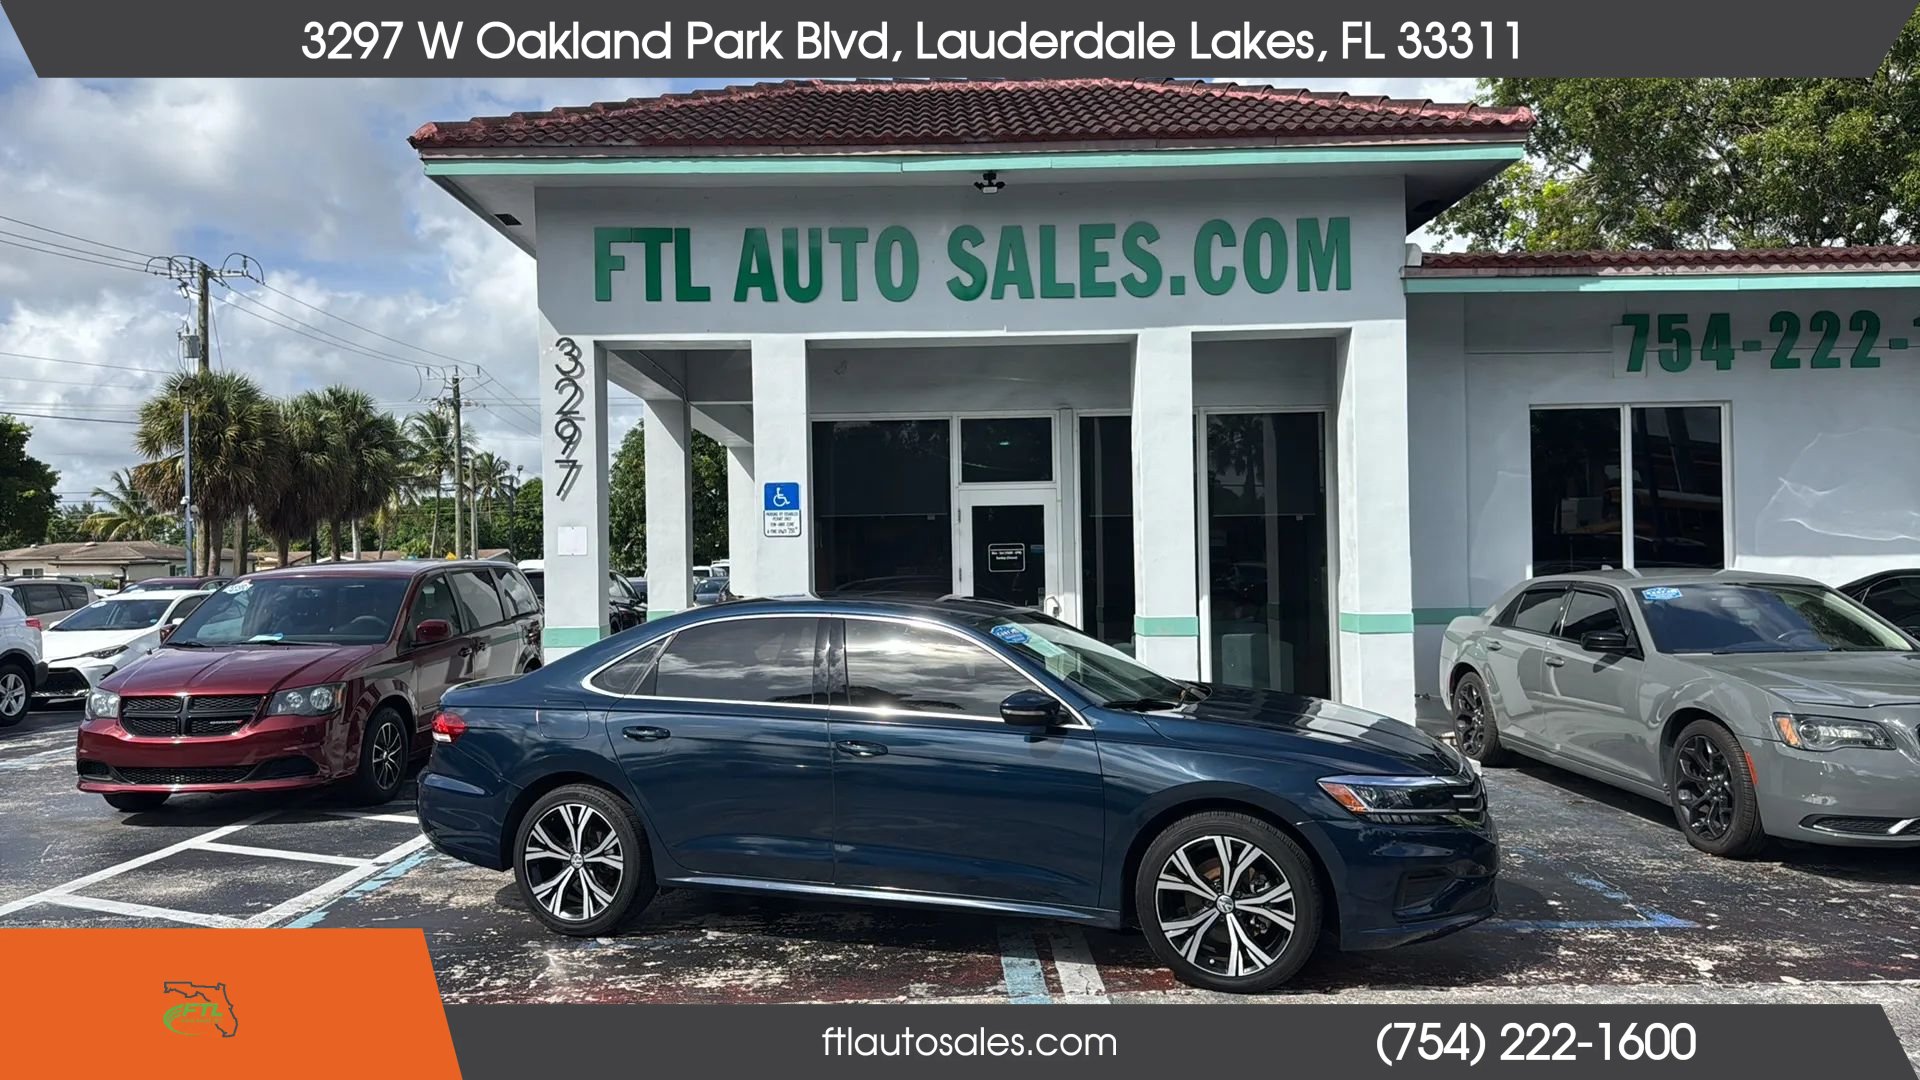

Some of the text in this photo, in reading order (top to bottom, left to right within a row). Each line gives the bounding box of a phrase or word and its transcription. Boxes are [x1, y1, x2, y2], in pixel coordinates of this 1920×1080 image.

[594, 216, 1352, 303] FTL AUTO SALES.COM
[1621, 309, 1920, 373] 754-222-
[554, 336, 584, 499] 3297
